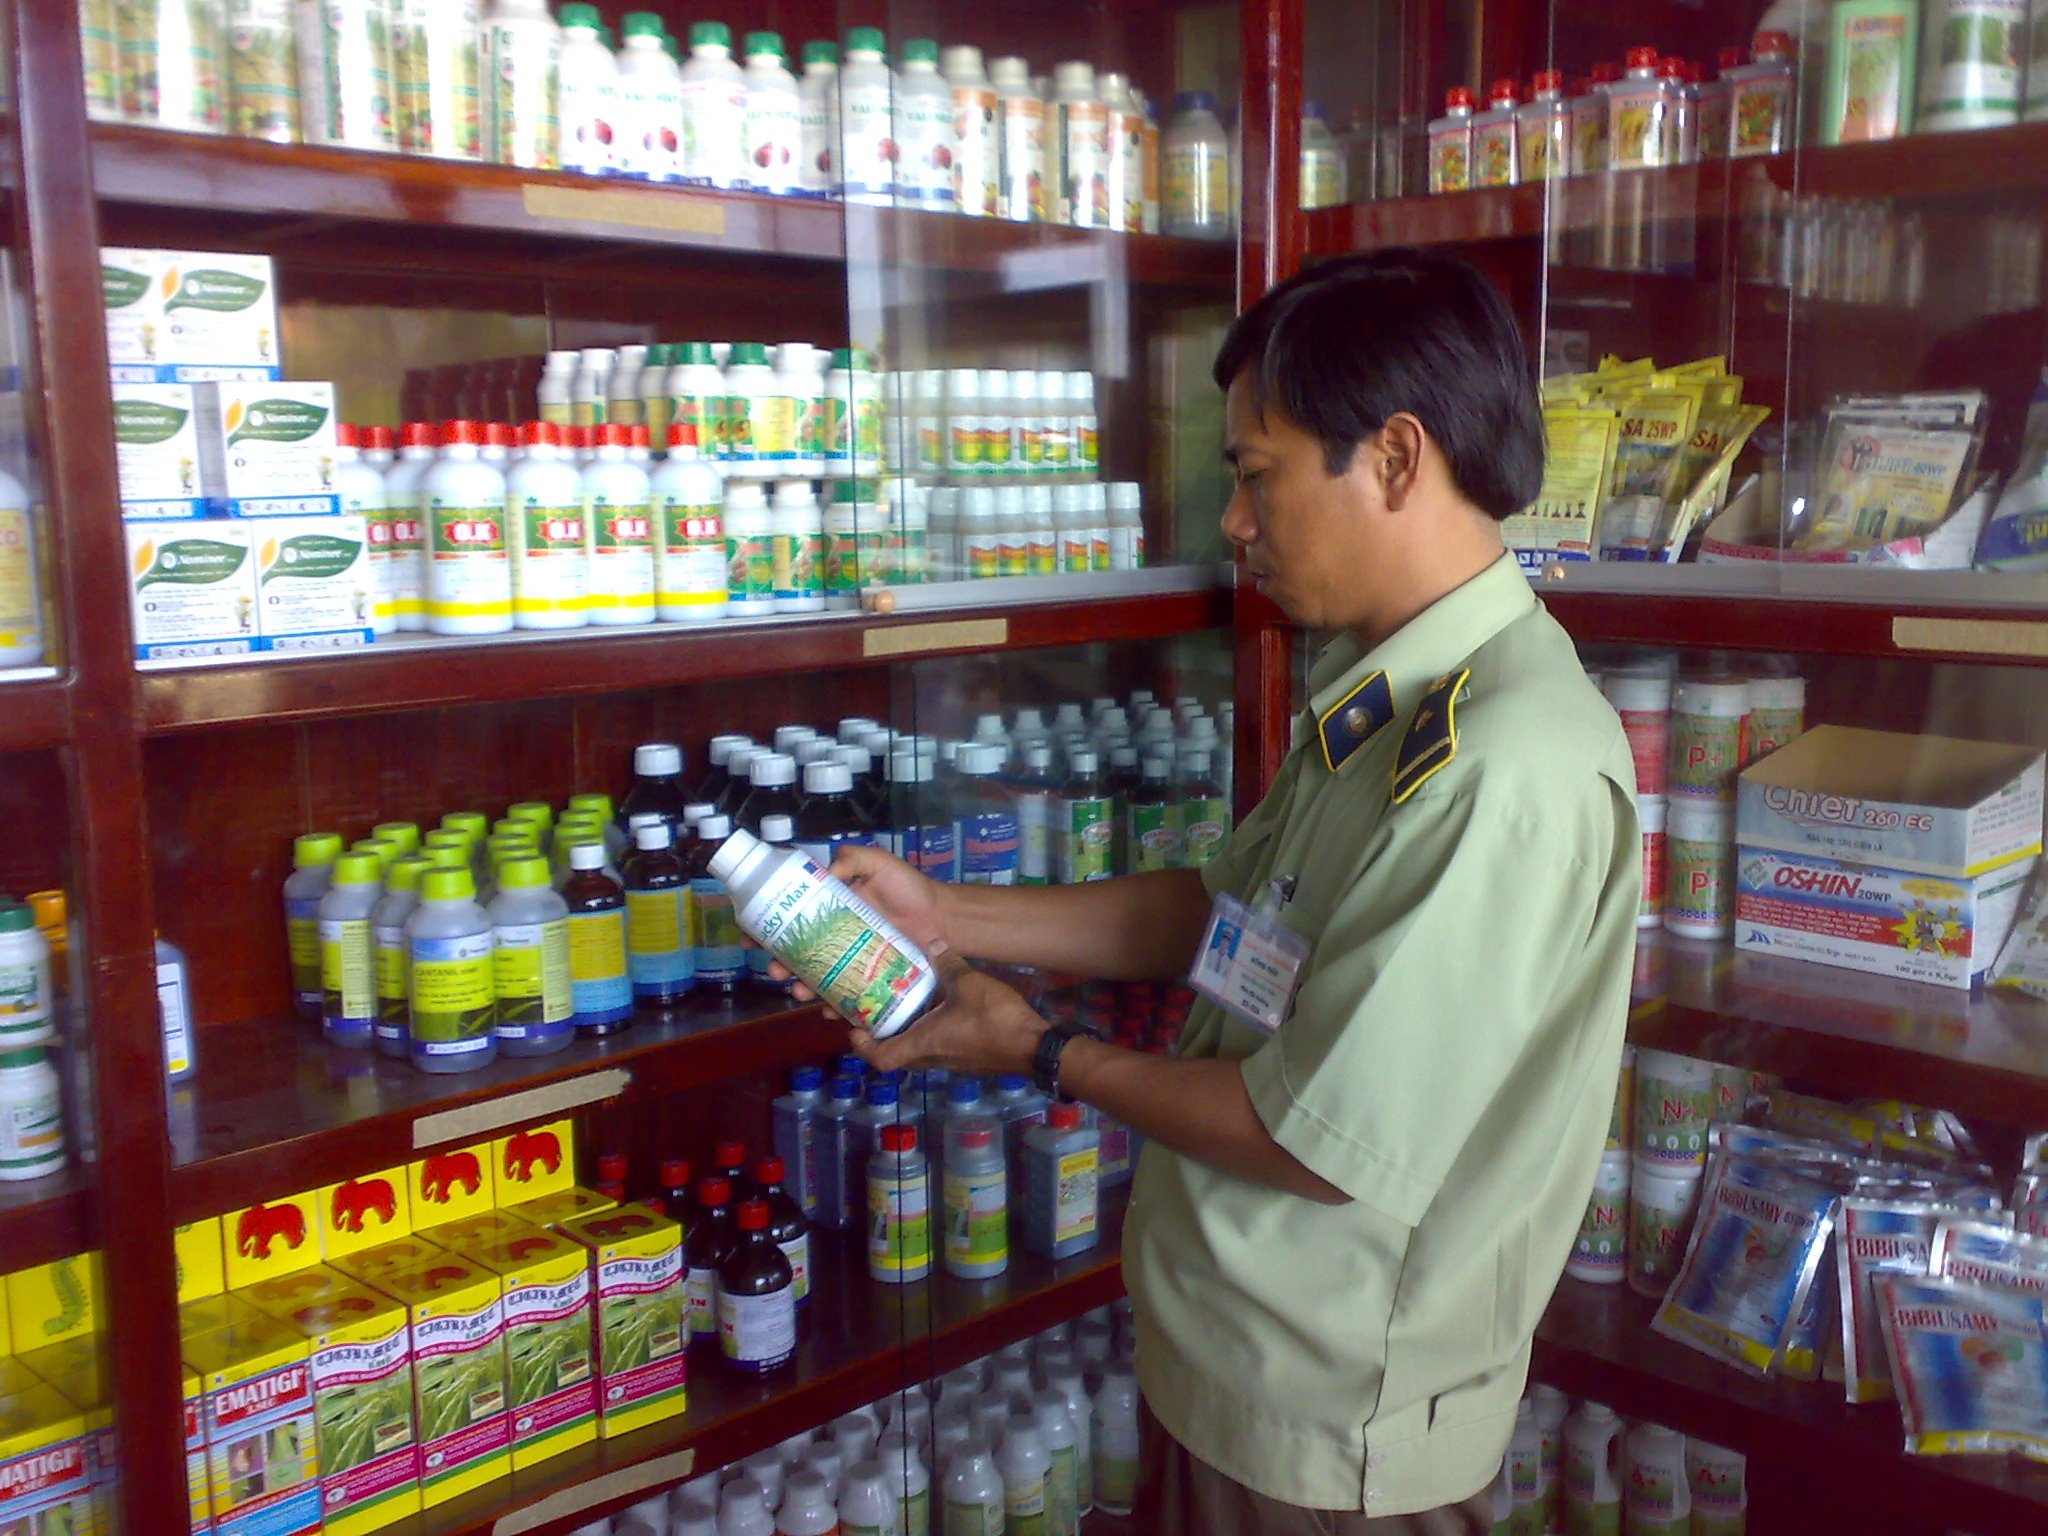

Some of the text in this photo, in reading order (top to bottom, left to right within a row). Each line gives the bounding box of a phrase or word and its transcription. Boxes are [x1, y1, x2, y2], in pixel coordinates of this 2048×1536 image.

[1621, 418, 1678, 440] SA 25WP
[1864, 808, 1901, 828] 260
[1904, 813, 1935, 832] EC
[779, 881, 810, 912] Max
[1773, 866, 1862, 899] OSHIN
[1858, 889, 1892, 903] 20WP
[1855, 1237, 1930, 1264] BiBiUSA
[215, 1369, 303, 1416] EMATIGI
[0, 1447, 73, 1490] MATIGI
